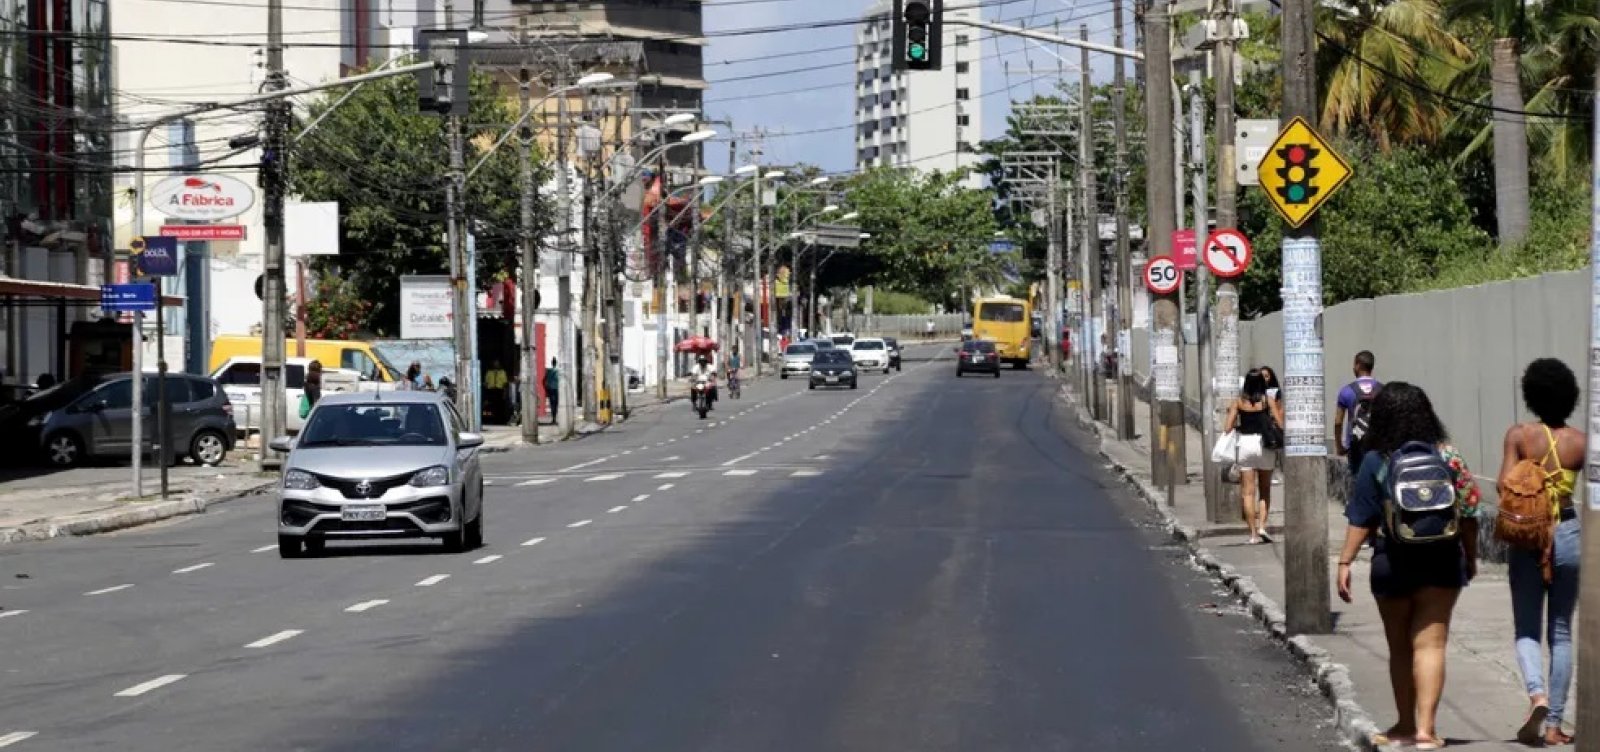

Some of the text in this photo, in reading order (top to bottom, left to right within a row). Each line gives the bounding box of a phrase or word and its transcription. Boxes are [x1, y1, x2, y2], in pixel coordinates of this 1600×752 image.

[169, 193, 234, 206] A Fábrica
[1150, 265, 1177, 282] 50
